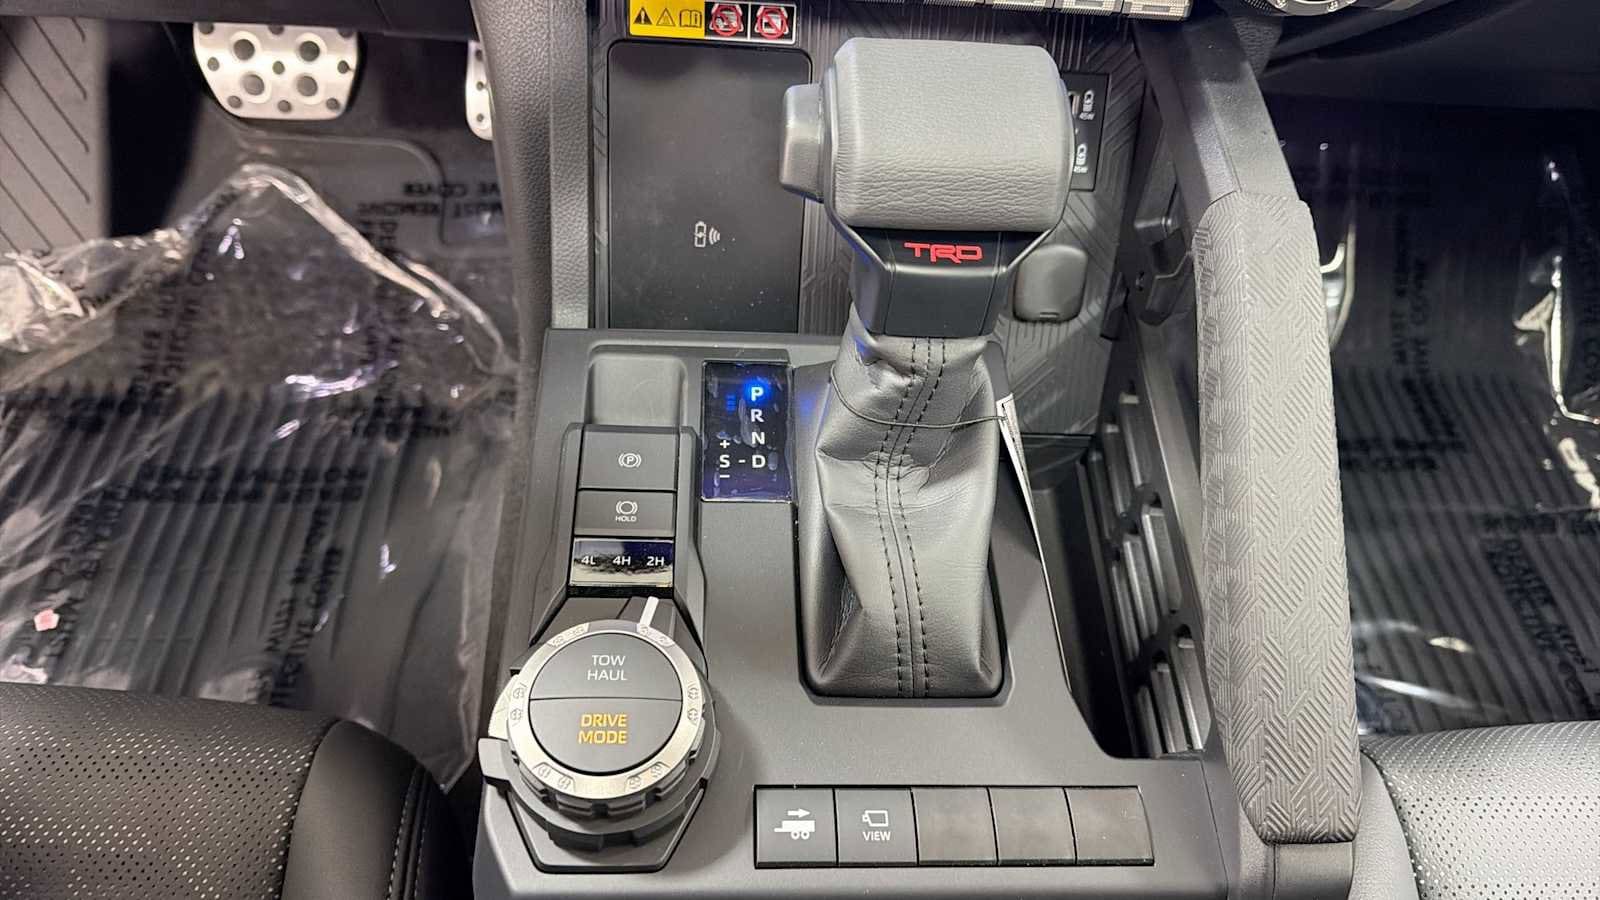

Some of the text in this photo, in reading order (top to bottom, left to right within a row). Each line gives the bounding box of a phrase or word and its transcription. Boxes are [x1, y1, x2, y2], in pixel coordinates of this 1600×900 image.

[904, 242, 983, 264] TRD
[751, 386, 764, 402] P
[750, 408, 765, 422] R
[751, 431, 766, 445] N
[719, 454, 766, 468] S D
[615, 515, 637, 523] HOLD
[581, 555, 665, 566] 4L 4H 2H
[591, 654, 626, 667] TOW
[587, 669, 628, 681] HAUL
[580, 713, 627, 727] DRIVE
[578, 730, 628, 745] MODE
[862, 831, 892, 841] VIEW
